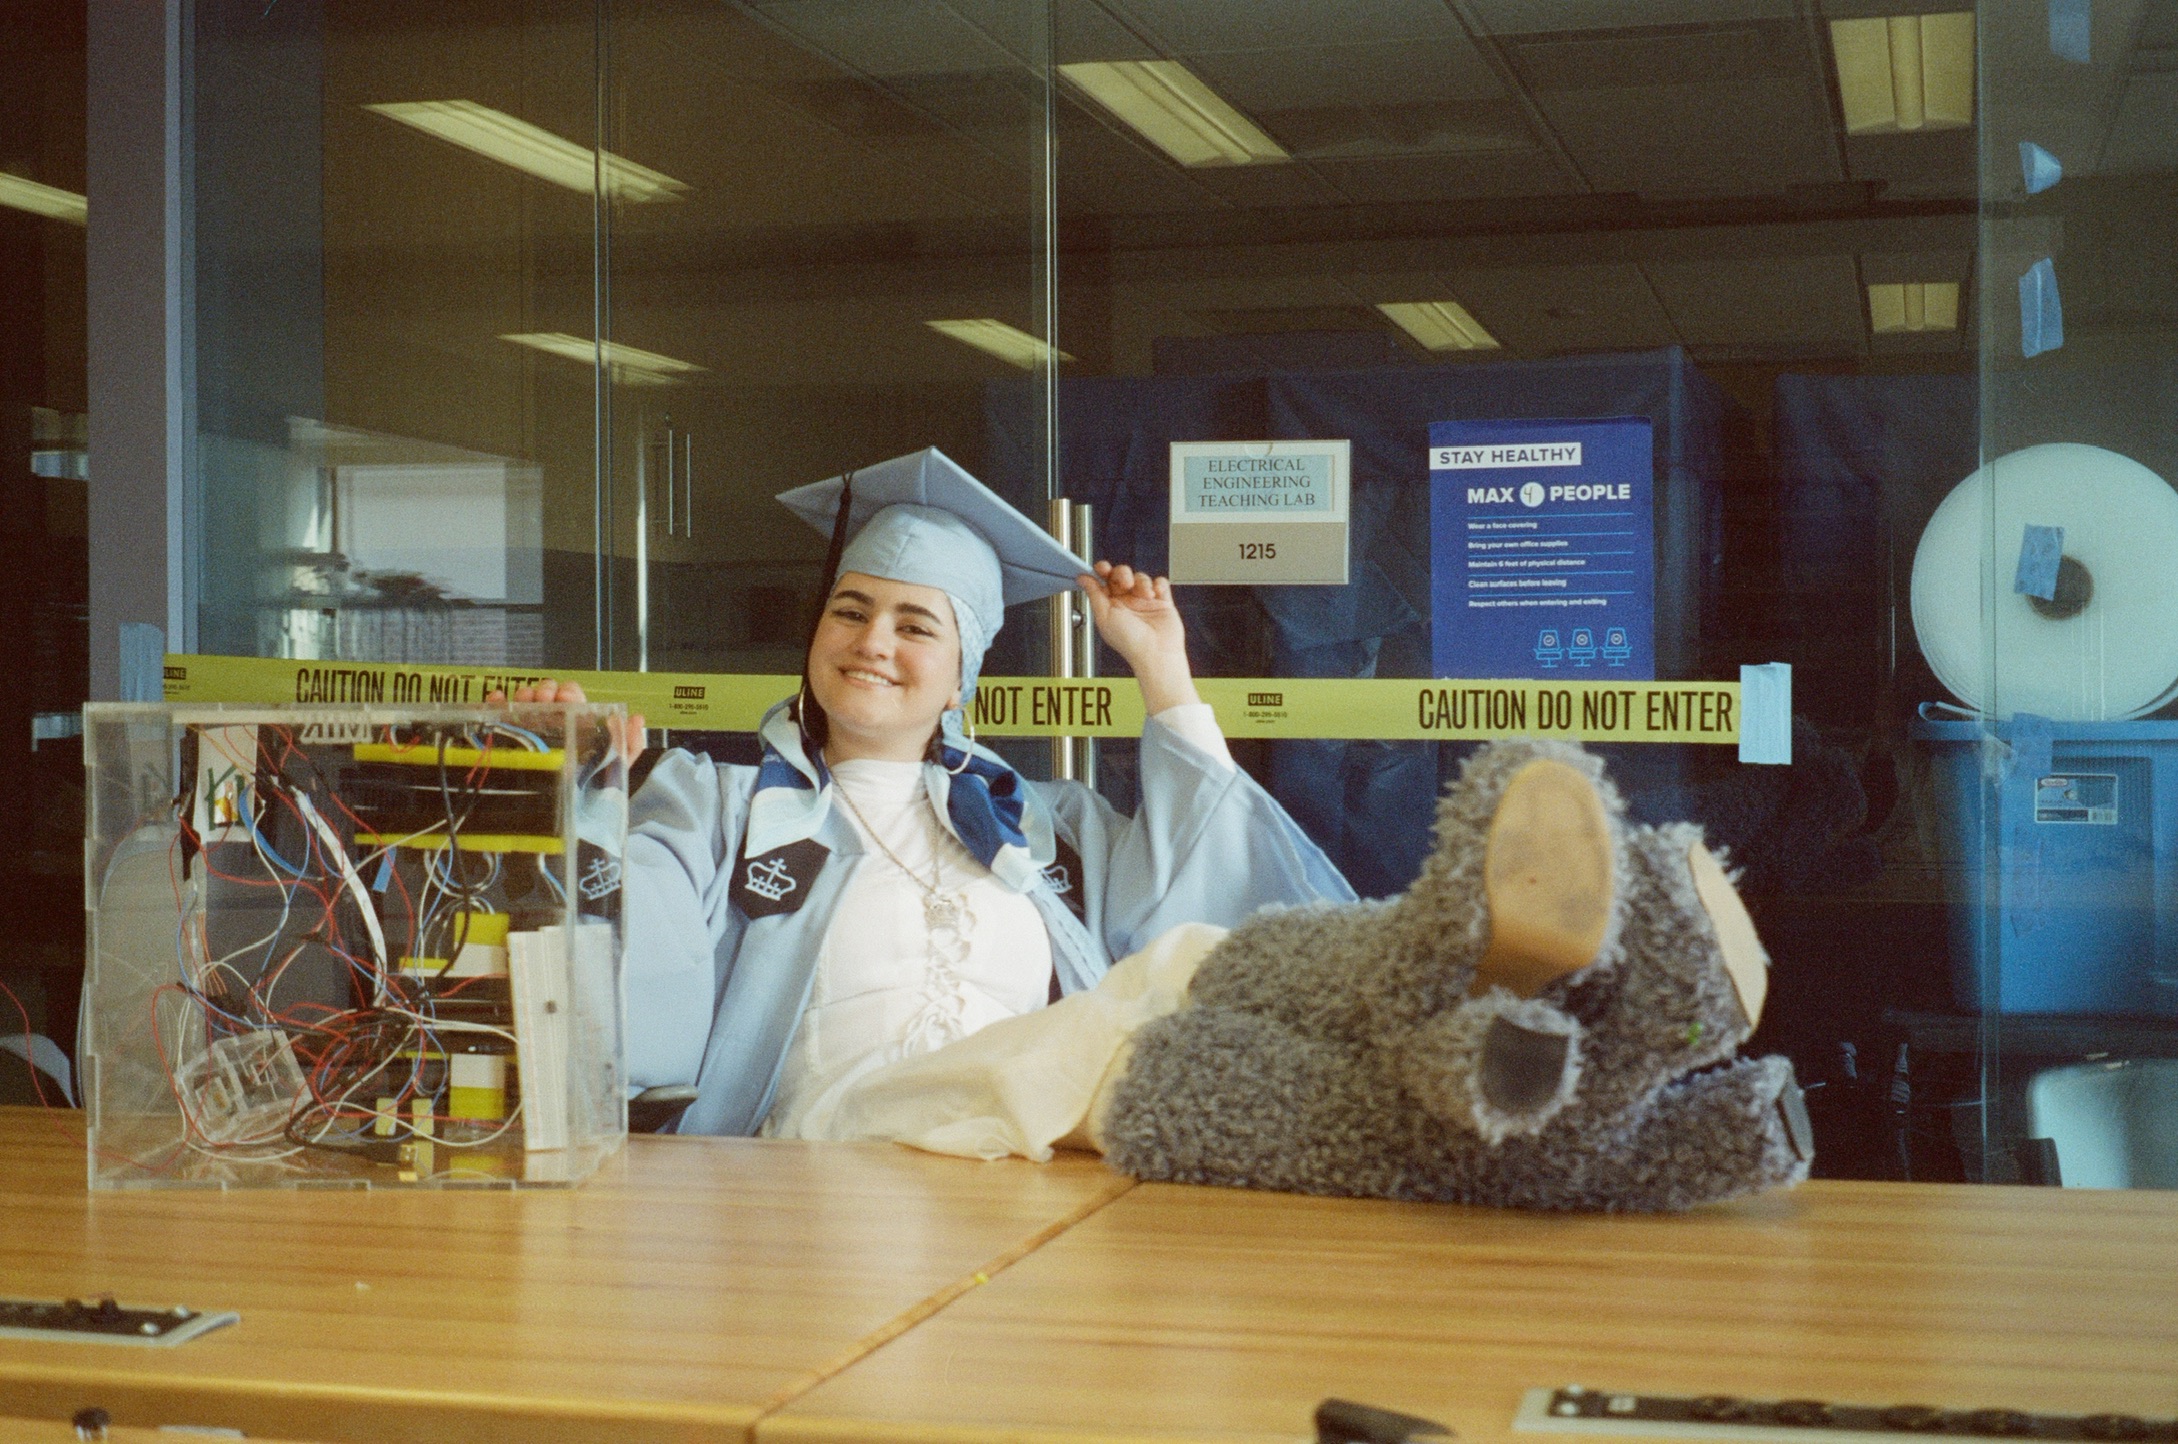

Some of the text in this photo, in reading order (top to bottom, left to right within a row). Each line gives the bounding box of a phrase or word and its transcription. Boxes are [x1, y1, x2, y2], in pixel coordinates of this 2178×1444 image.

[1440, 447, 1576, 465] STAY HEALTHY
[1208, 458, 1305, 473] ELECTRICAL
[1203, 475, 1311, 490] ENGINEERING
[1199, 493, 1316, 508] TEACHING LAB
[1467, 486, 1514, 504] MAX
[1550, 483, 1631, 501] PEOPLE
[1467, 522, 1486, 530] Wear
[1508, 521, 1538, 530] covering
[1238, 543, 1277, 560] 1215
[1467, 541, 1487, 550] Bring
[1487, 542, 1503, 550] your
[1519, 540, 1539, 548] office
[1540, 539, 1569, 548] supplies
[1468, 560, 1498, 568] Maintain
[1504, 559, 1519, 567] feet
[1519, 559, 1527, 567] of
[1528, 558, 1556, 568] physical
[1556, 558, 1586, 566] distance
[1468, 578, 1568, 588] Clean surfaces before leaving
[1468, 600, 1496, 608] Respect
[1539, 599, 1568, 607] entering
[1568, 598, 1582, 606] and
[1583, 598, 1608, 606] exiting
[296, 668, 385, 703] CAUTION
[393, 672, 422, 703] DO
[430, 674, 476, 703] NOT
[675, 687, 704, 698] ULINE
[974, 686, 1112, 726] NOT ENTER
[1249, 694, 1282, 705] ULINE
[1419, 688, 1733, 732] CAUTION DO NOT ENTER
